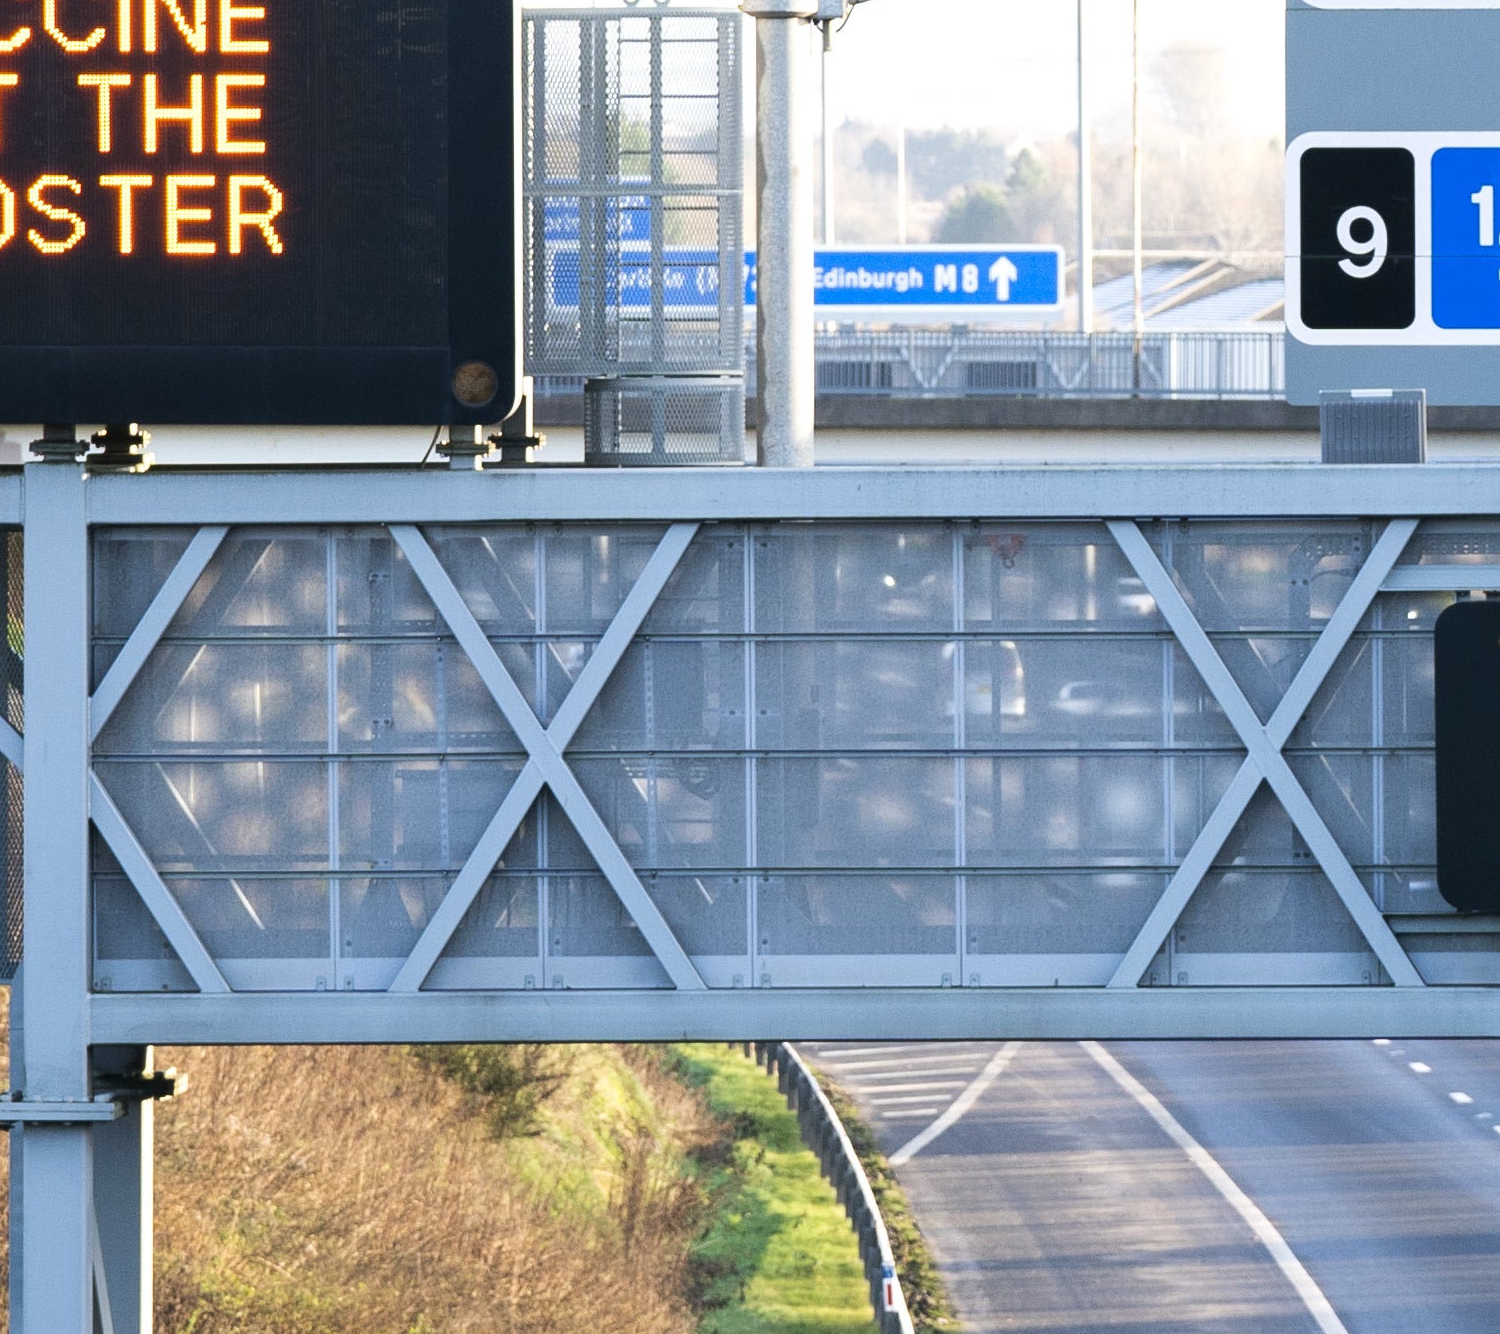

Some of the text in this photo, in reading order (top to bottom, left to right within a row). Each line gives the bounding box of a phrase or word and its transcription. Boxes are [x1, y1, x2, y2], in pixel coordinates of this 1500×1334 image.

[77, 72, 267, 155] THE
[813, 267, 923, 292] Edinburgh
[1337, 205, 1389, 280] 9
